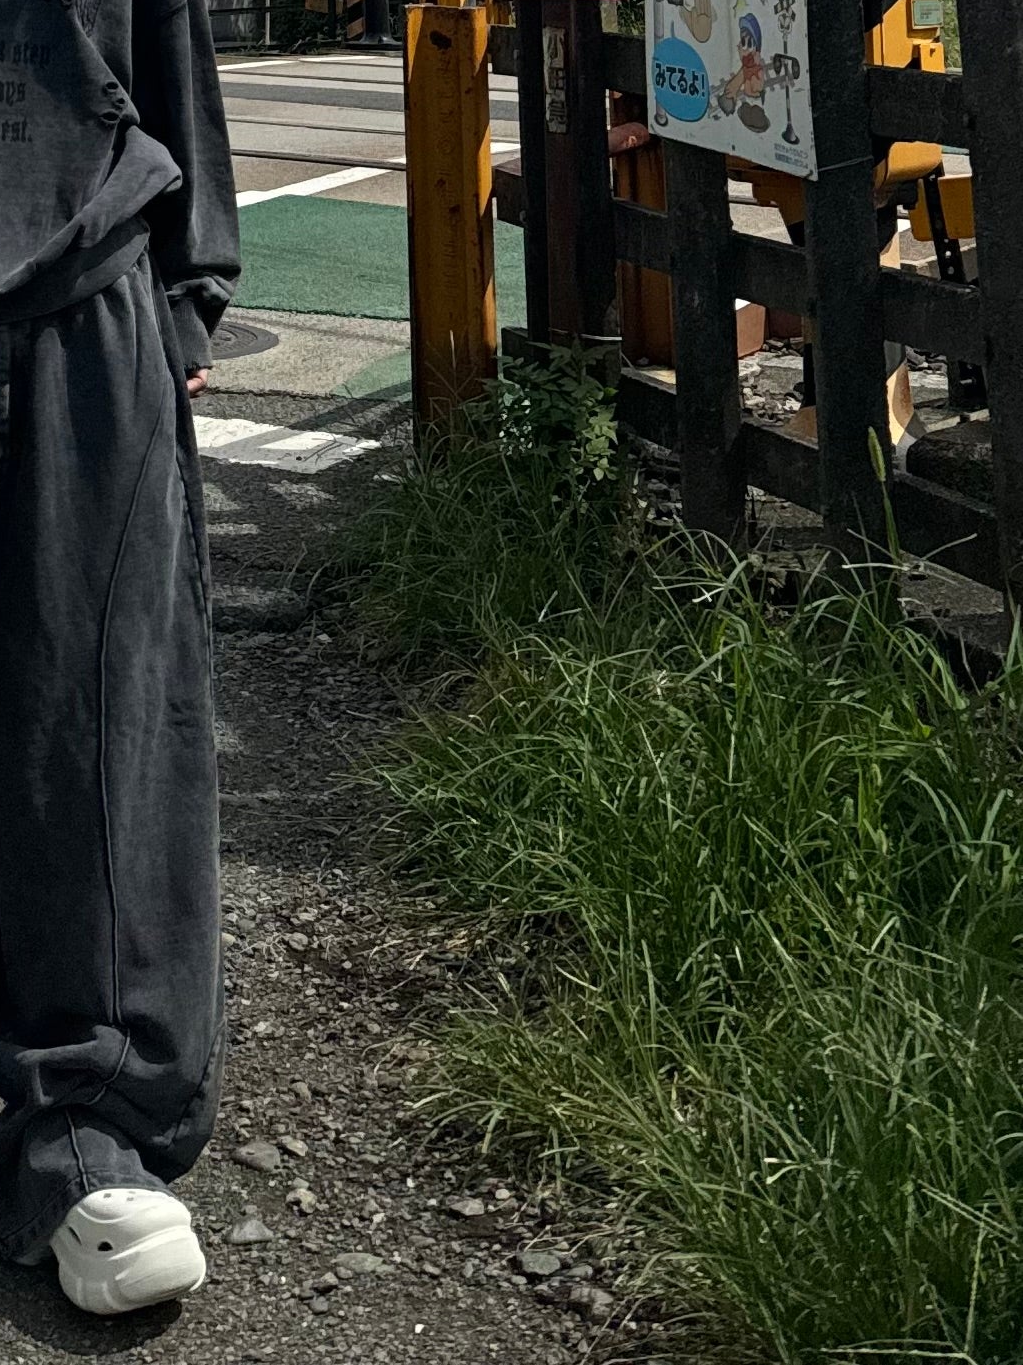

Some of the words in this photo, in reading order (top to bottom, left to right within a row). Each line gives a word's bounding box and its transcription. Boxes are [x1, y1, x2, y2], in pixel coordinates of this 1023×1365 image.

[13, 39, 51, 68] step
[655, 62, 706, 98] みてるよ!
